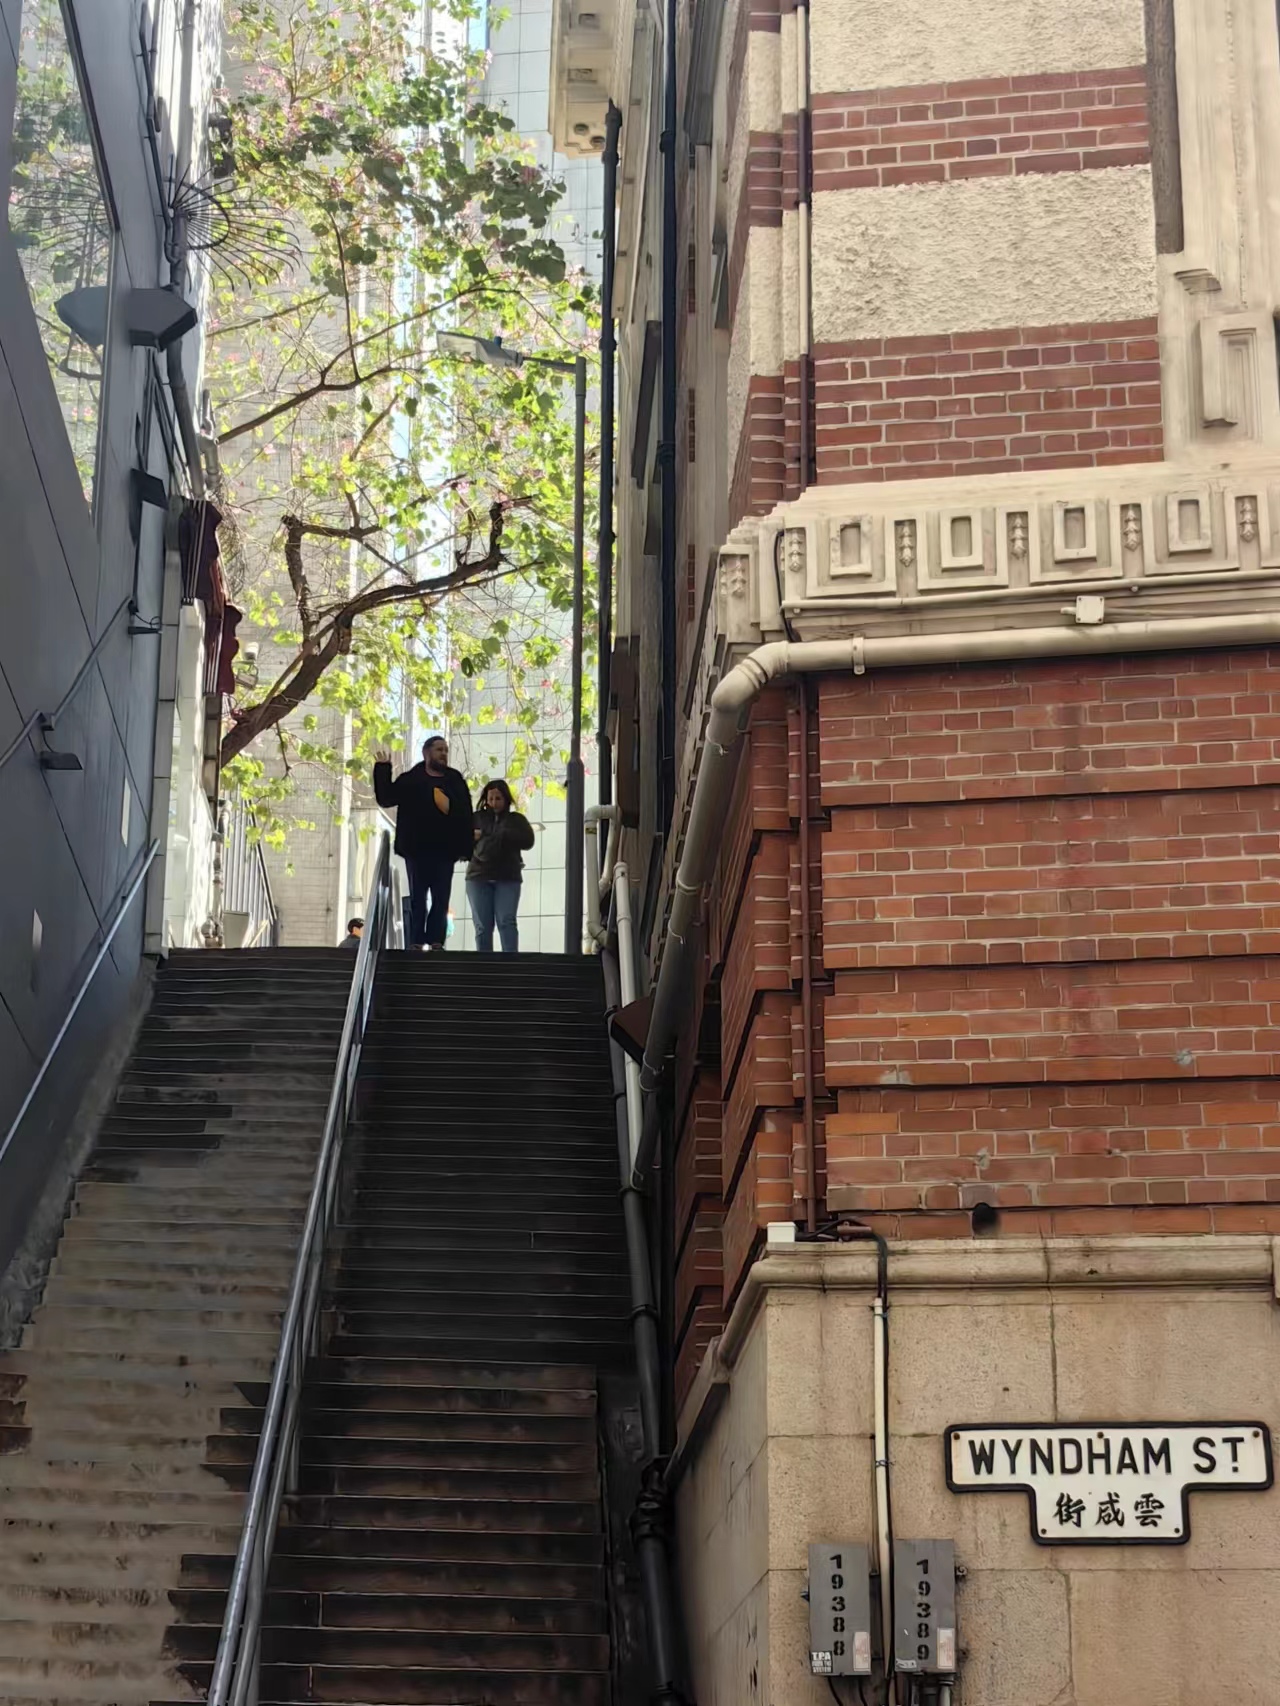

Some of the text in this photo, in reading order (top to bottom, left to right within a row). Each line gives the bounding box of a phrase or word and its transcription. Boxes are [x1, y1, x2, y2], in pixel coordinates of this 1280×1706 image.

[969, 1438, 1171, 1475] WYNDHAM
[830, 1554, 846, 1656] 19388
[916, 1559, 931, 1660] 19389
